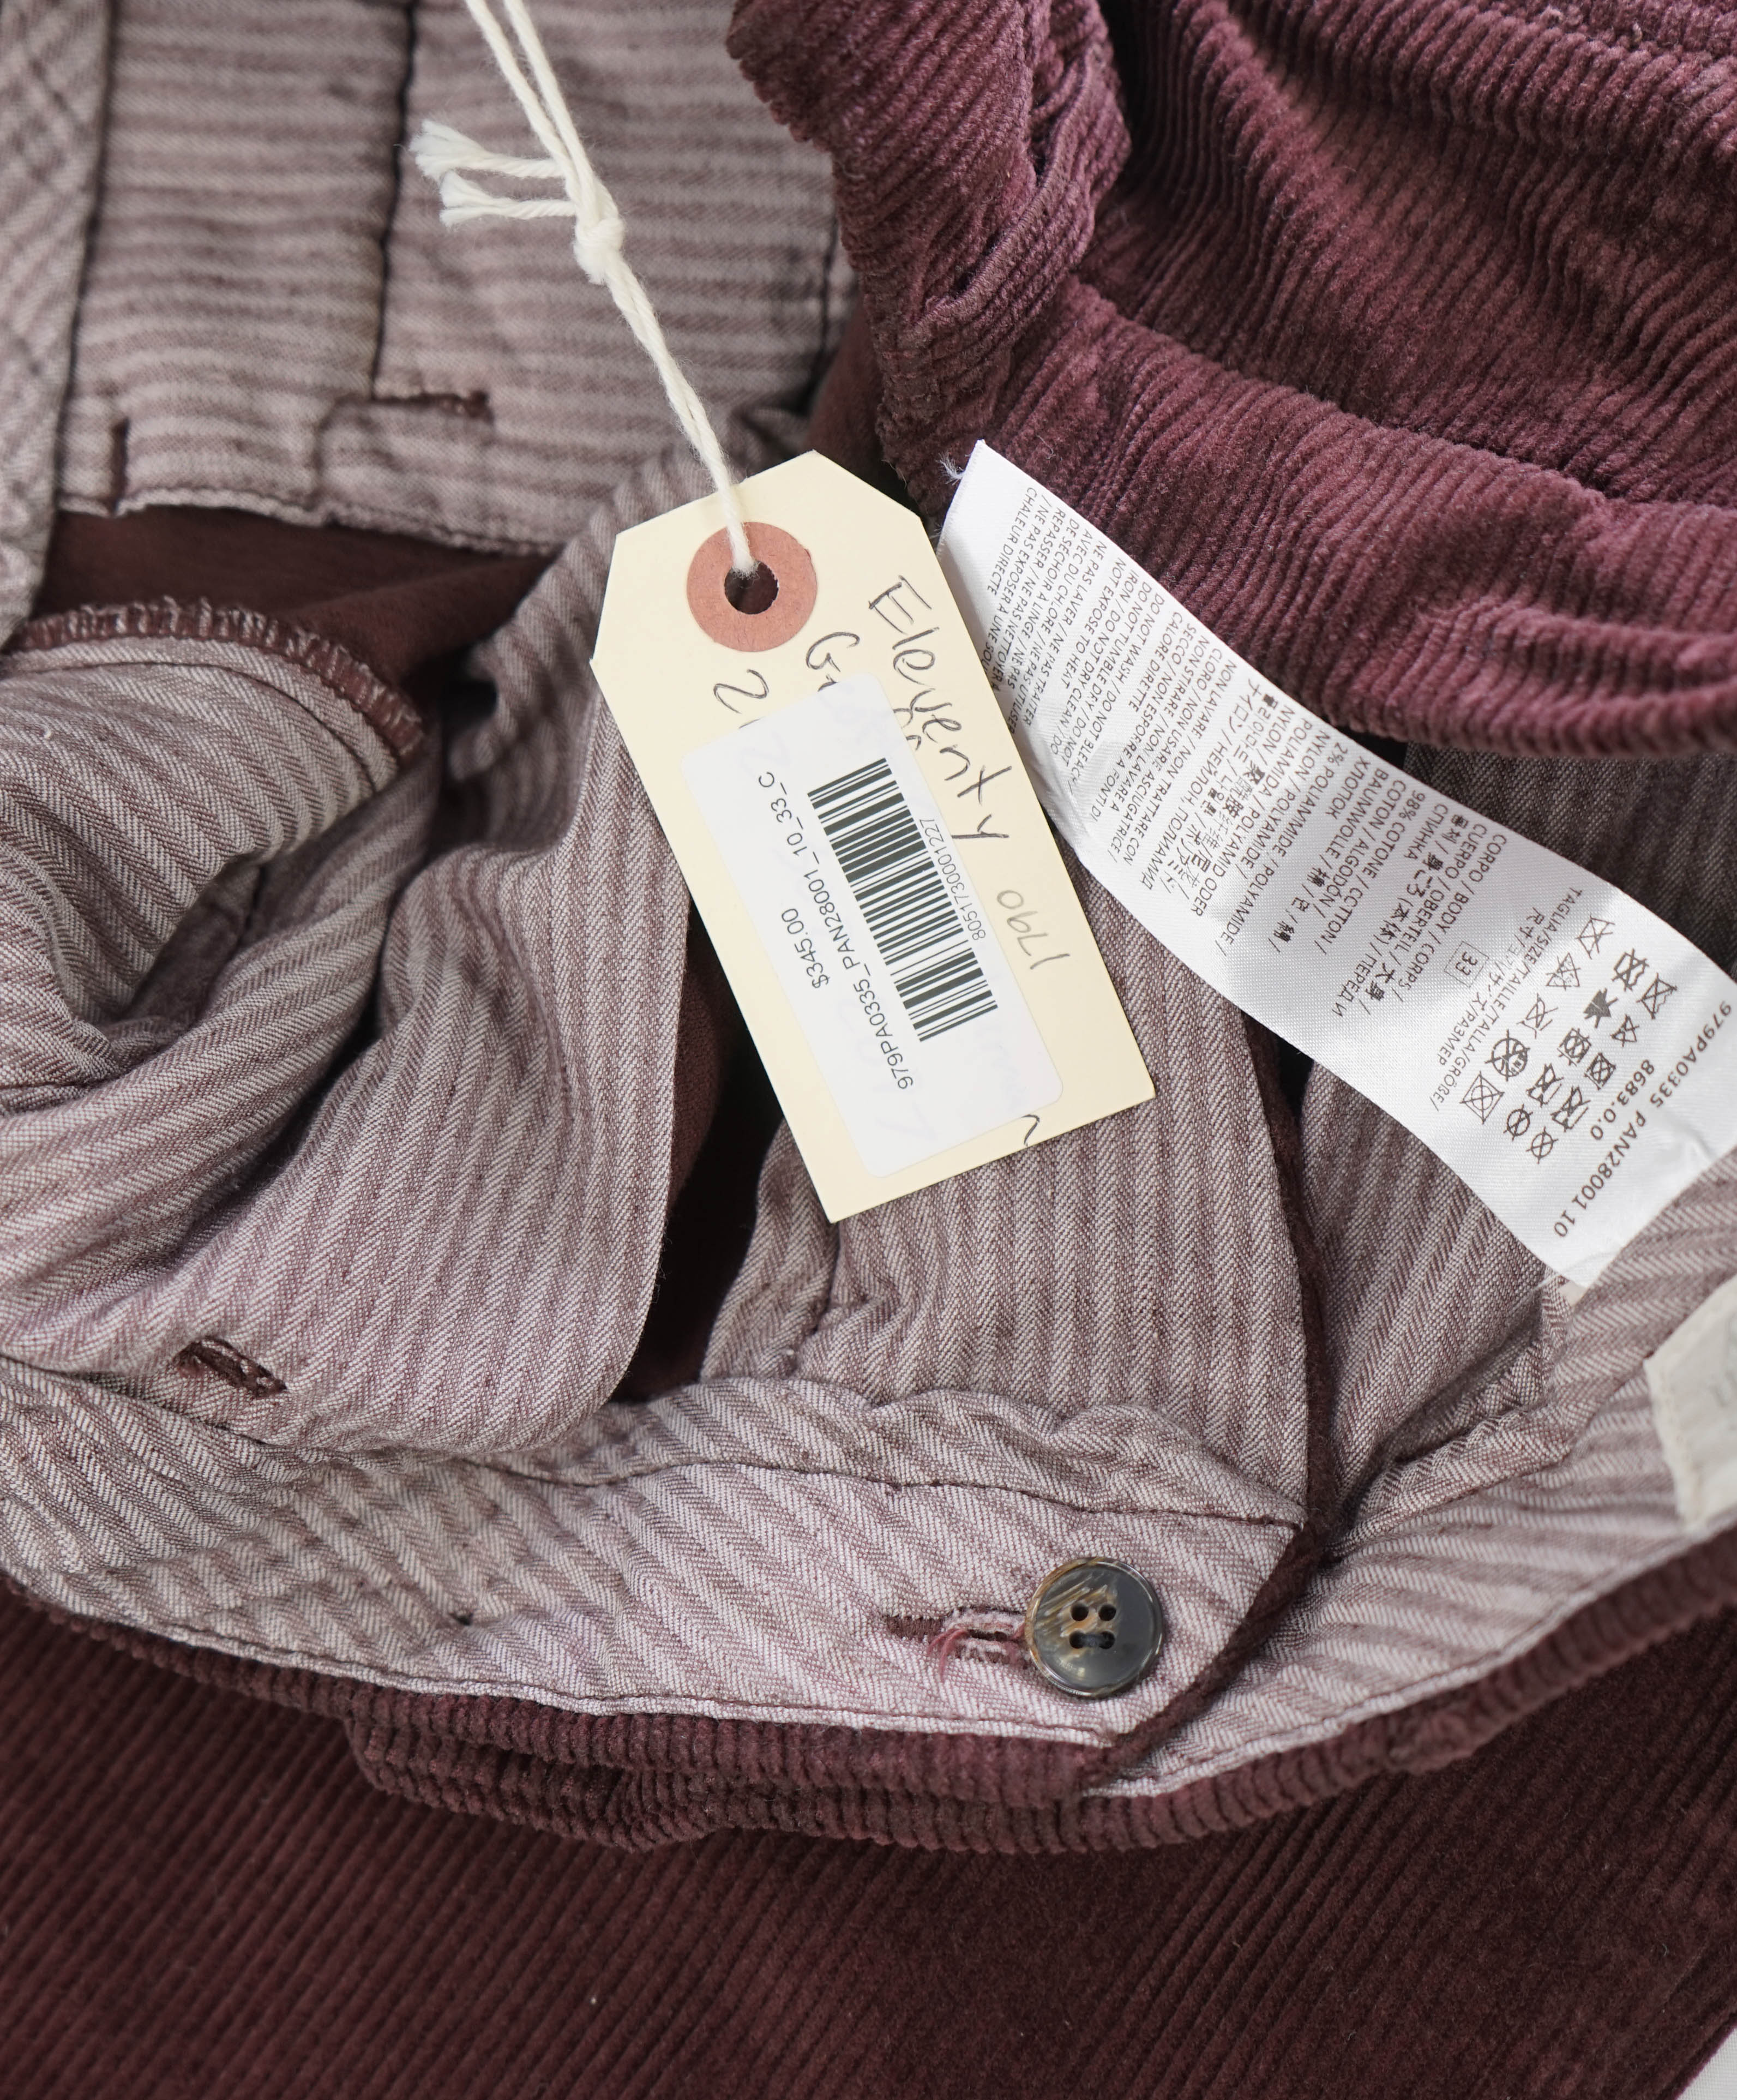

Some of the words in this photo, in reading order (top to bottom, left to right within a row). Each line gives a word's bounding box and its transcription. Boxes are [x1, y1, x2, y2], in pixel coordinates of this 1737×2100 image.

[1006, 487, 1038, 544] CHALEUR
[1033, 504, 1049, 525] NE
[1065, 518, 1080, 538] DE
[1023, 523, 1041, 550] PAS
[1032, 507, 1066, 569] REPASSER
[1072, 528, 1093, 565] AVEC
[1092, 540, 1107, 561] NE
[986, 543, 1014, 596] DIRECTE
[1000, 549, 1030, 604] EXPOSER
[1041, 535, 1072, 591] SÉCHOIR
[1063, 562, 1079, 585] DU
[1081, 559, 1099, 585] PAS
[1109, 557, 1127, 588] NOT
[1020, 575, 1036, 597] NE
[1061, 583, 1087, 626] LAVER
[1119, 569, 1139, 603] IRON
[1137, 580, 1152, 603] DO
[1149, 592, 1165, 615] DO
[987, 614, 1003, 644] UNE
[1011, 595, 1029, 621] PAS
[1020, 601, 1043, 639] LINGE
[1040, 584, 1068, 635] CHLORE
[1083, 585, 1115, 635] EXPOSE
[1104, 609, 1121, 633] DO
[1123, 601, 1143, 634] NOT
[991, 619, 1019, 682] NETTOYER
[1048, 632, 1065, 655] NE
[1075, 634, 1091, 654] TO
[1089, 631, 1110, 664] NOT
[1136, 613, 1156, 646] NOT
[1153, 611, 1183, 662] CALORE
[1170, 622, 1197, 665] SECCO
[1011, 646, 1025, 667] NE
[1022, 658, 1038, 686] PAS
[1029, 640, 1043, 662] NE
[1040, 651, 1056, 677] PAS
[1060, 652, 1081, 689] HEAT
[1096, 632, 1129, 685] TUMBLE
[1114, 643, 1142, 685] WASH
[1187, 635, 1210, 668] NON
[1195, 647, 1222, 691] CLORO
[1006, 665, 1021, 689] PAS
[1077, 661, 1095, 689] DRY
[1127, 658, 1161, 713] DIRETTE
[1150, 671, 1173, 705] NON
[1163, 664, 1194, 718] STIRARE
[1214, 659, 1237, 692] NON
[868, 575, 1012, 841] Eleventy
[1022, 677, 1047, 727] TRAITER
[1059, 687, 1082, 728] CLEAN
[1101, 689, 1117, 712] DO
[1175, 696, 1198, 731] NON
[1191, 689, 1222, 740] LAVARE
[1228, 678, 1262, 734] ナイロン
[1049, 733, 1063, 755] DO
[1071, 716, 1087, 739] DO
[1088, 710, 1108, 741] NOT
[1142, 723, 1165, 757] NON
[1261, 705, 1296, 754] NYLON
[1060, 735, 1078, 767] NOT
[1153, 728, 1182, 772] USARE
[1165, 745, 1192, 779] NON
[1257, 717, 1313, 797] POLIAMIDA
[1293, 729, 1331, 782] NYLON
[1326, 741, 1349, 766] 2%
[1095, 767, 1120, 807] FONTI
[1114, 753, 1147, 803] LAVARE
[1324, 755, 1372, 820] ХЛОПОК
[1089, 804, 1102, 822] DI
[1110, 768, 1156, 854] ASCIUGATRICE
[1133, 778, 1172, 839] TRATTARE
[1270, 764, 1336, 858] POLIAMMIDE
[1324, 767, 1390, 860] BAUMWOLLE
[1367, 779, 1407, 830] COTON
[1397, 789, 1426, 821] 98%
[1139, 806, 1189, 891] ПОЛИАМИД
[1211, 806, 1261, 878] POLYAMID
[1239, 788, 1297, 869] POLYAMIDE
[1402, 802, 1449, 861] СПИНКА
[1122, 836, 1140, 866] CON
[1361, 821, 1406, 879] COTONE
[1444, 823, 1488, 880] CUERPO
[1467, 833, 1507, 884] CORPO
[918, 818, 987, 941] 8051730001227
[1318, 837, 1370, 908] ALGODÓN
[1189, 877, 1218, 917] ODER
[1219, 863, 1276, 945] POLYAMIDE
[1434, 891, 1470, 935] BODY
[757, 771, 914, 1090] 979PA0335_PAN28001_10_33_C
[1393, 889, 1445, 953] OBERTEIL
[780, 907, 831, 989] $345.00
[1397, 941, 1435, 992] CORPS
[1451, 950, 1479, 977] 33
[1337, 952, 1378, 1006] ПЕРЕД
[1329, 999, 1348, 1019] И
[1649, 1000, 1732, 1108] 979PA0335
[1589, 1058, 1655, 1142] 8683.0.0
[1570, 1109, 1647, 1210] PAN28001
[1553, 1209, 1576, 1238] 10
